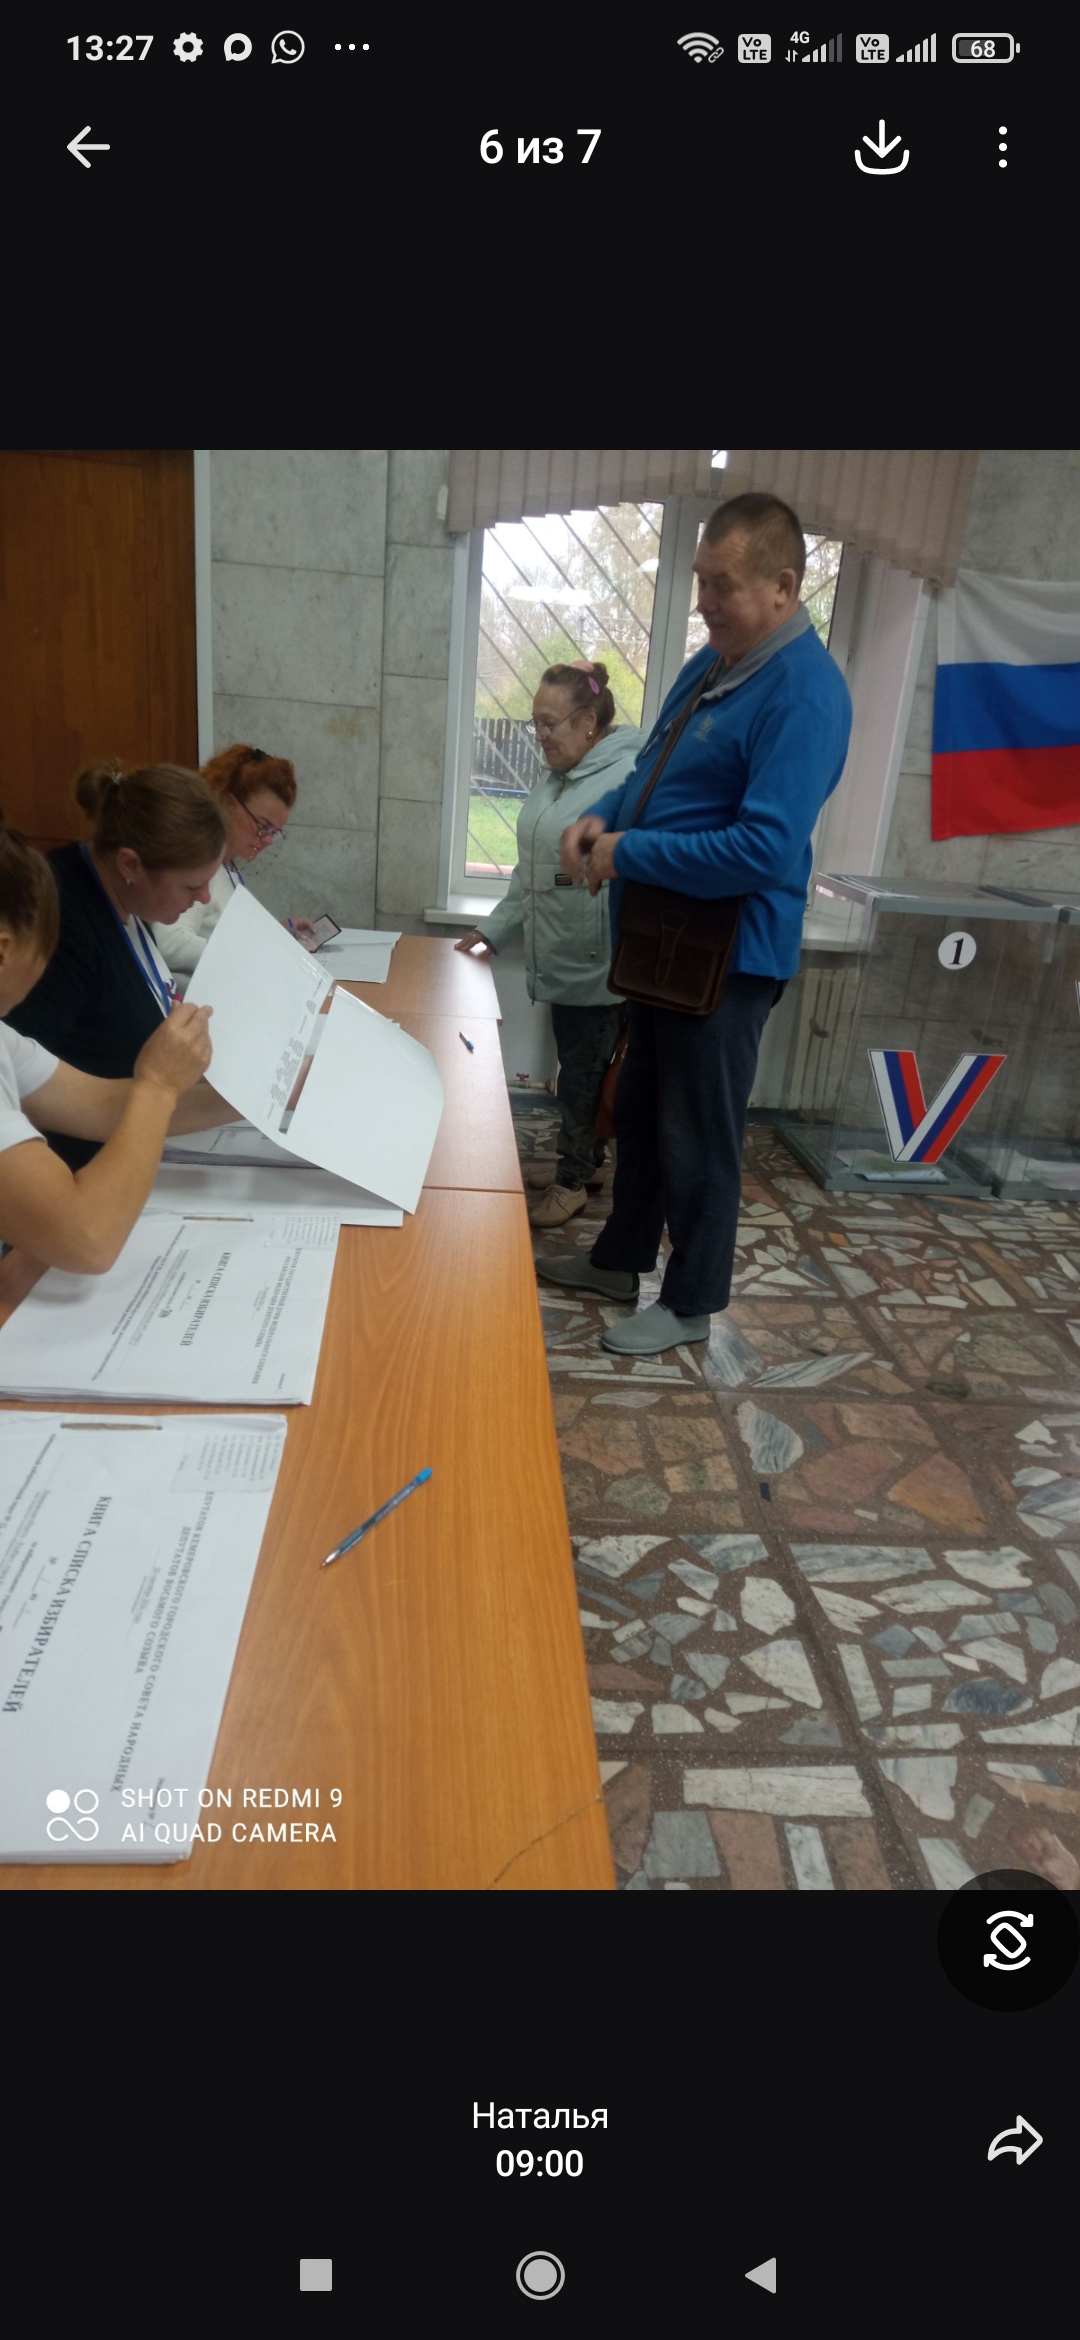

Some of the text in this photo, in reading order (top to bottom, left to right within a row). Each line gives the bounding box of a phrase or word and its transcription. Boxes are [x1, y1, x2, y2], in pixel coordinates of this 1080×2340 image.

[950, 938, 964, 965] 1
[179, 1299, 210, 1346] ИЗБИРАТЕЛЕЙ
[82, 1495, 112, 1536] КНИГА
[55, 1539, 92, 1595] СПИСКА
[1, 1599, 66, 1714] ИЗБИРАТЕЛЕЙ
[109, 1490, 214, 1792] ЕПУТАТОВ КЕМЕРОВСКОГО ГОРОДСКОГО СОВЕТА НАРОДНЫХ
[133, 1630, 156, 1673] СОЗЫВА
